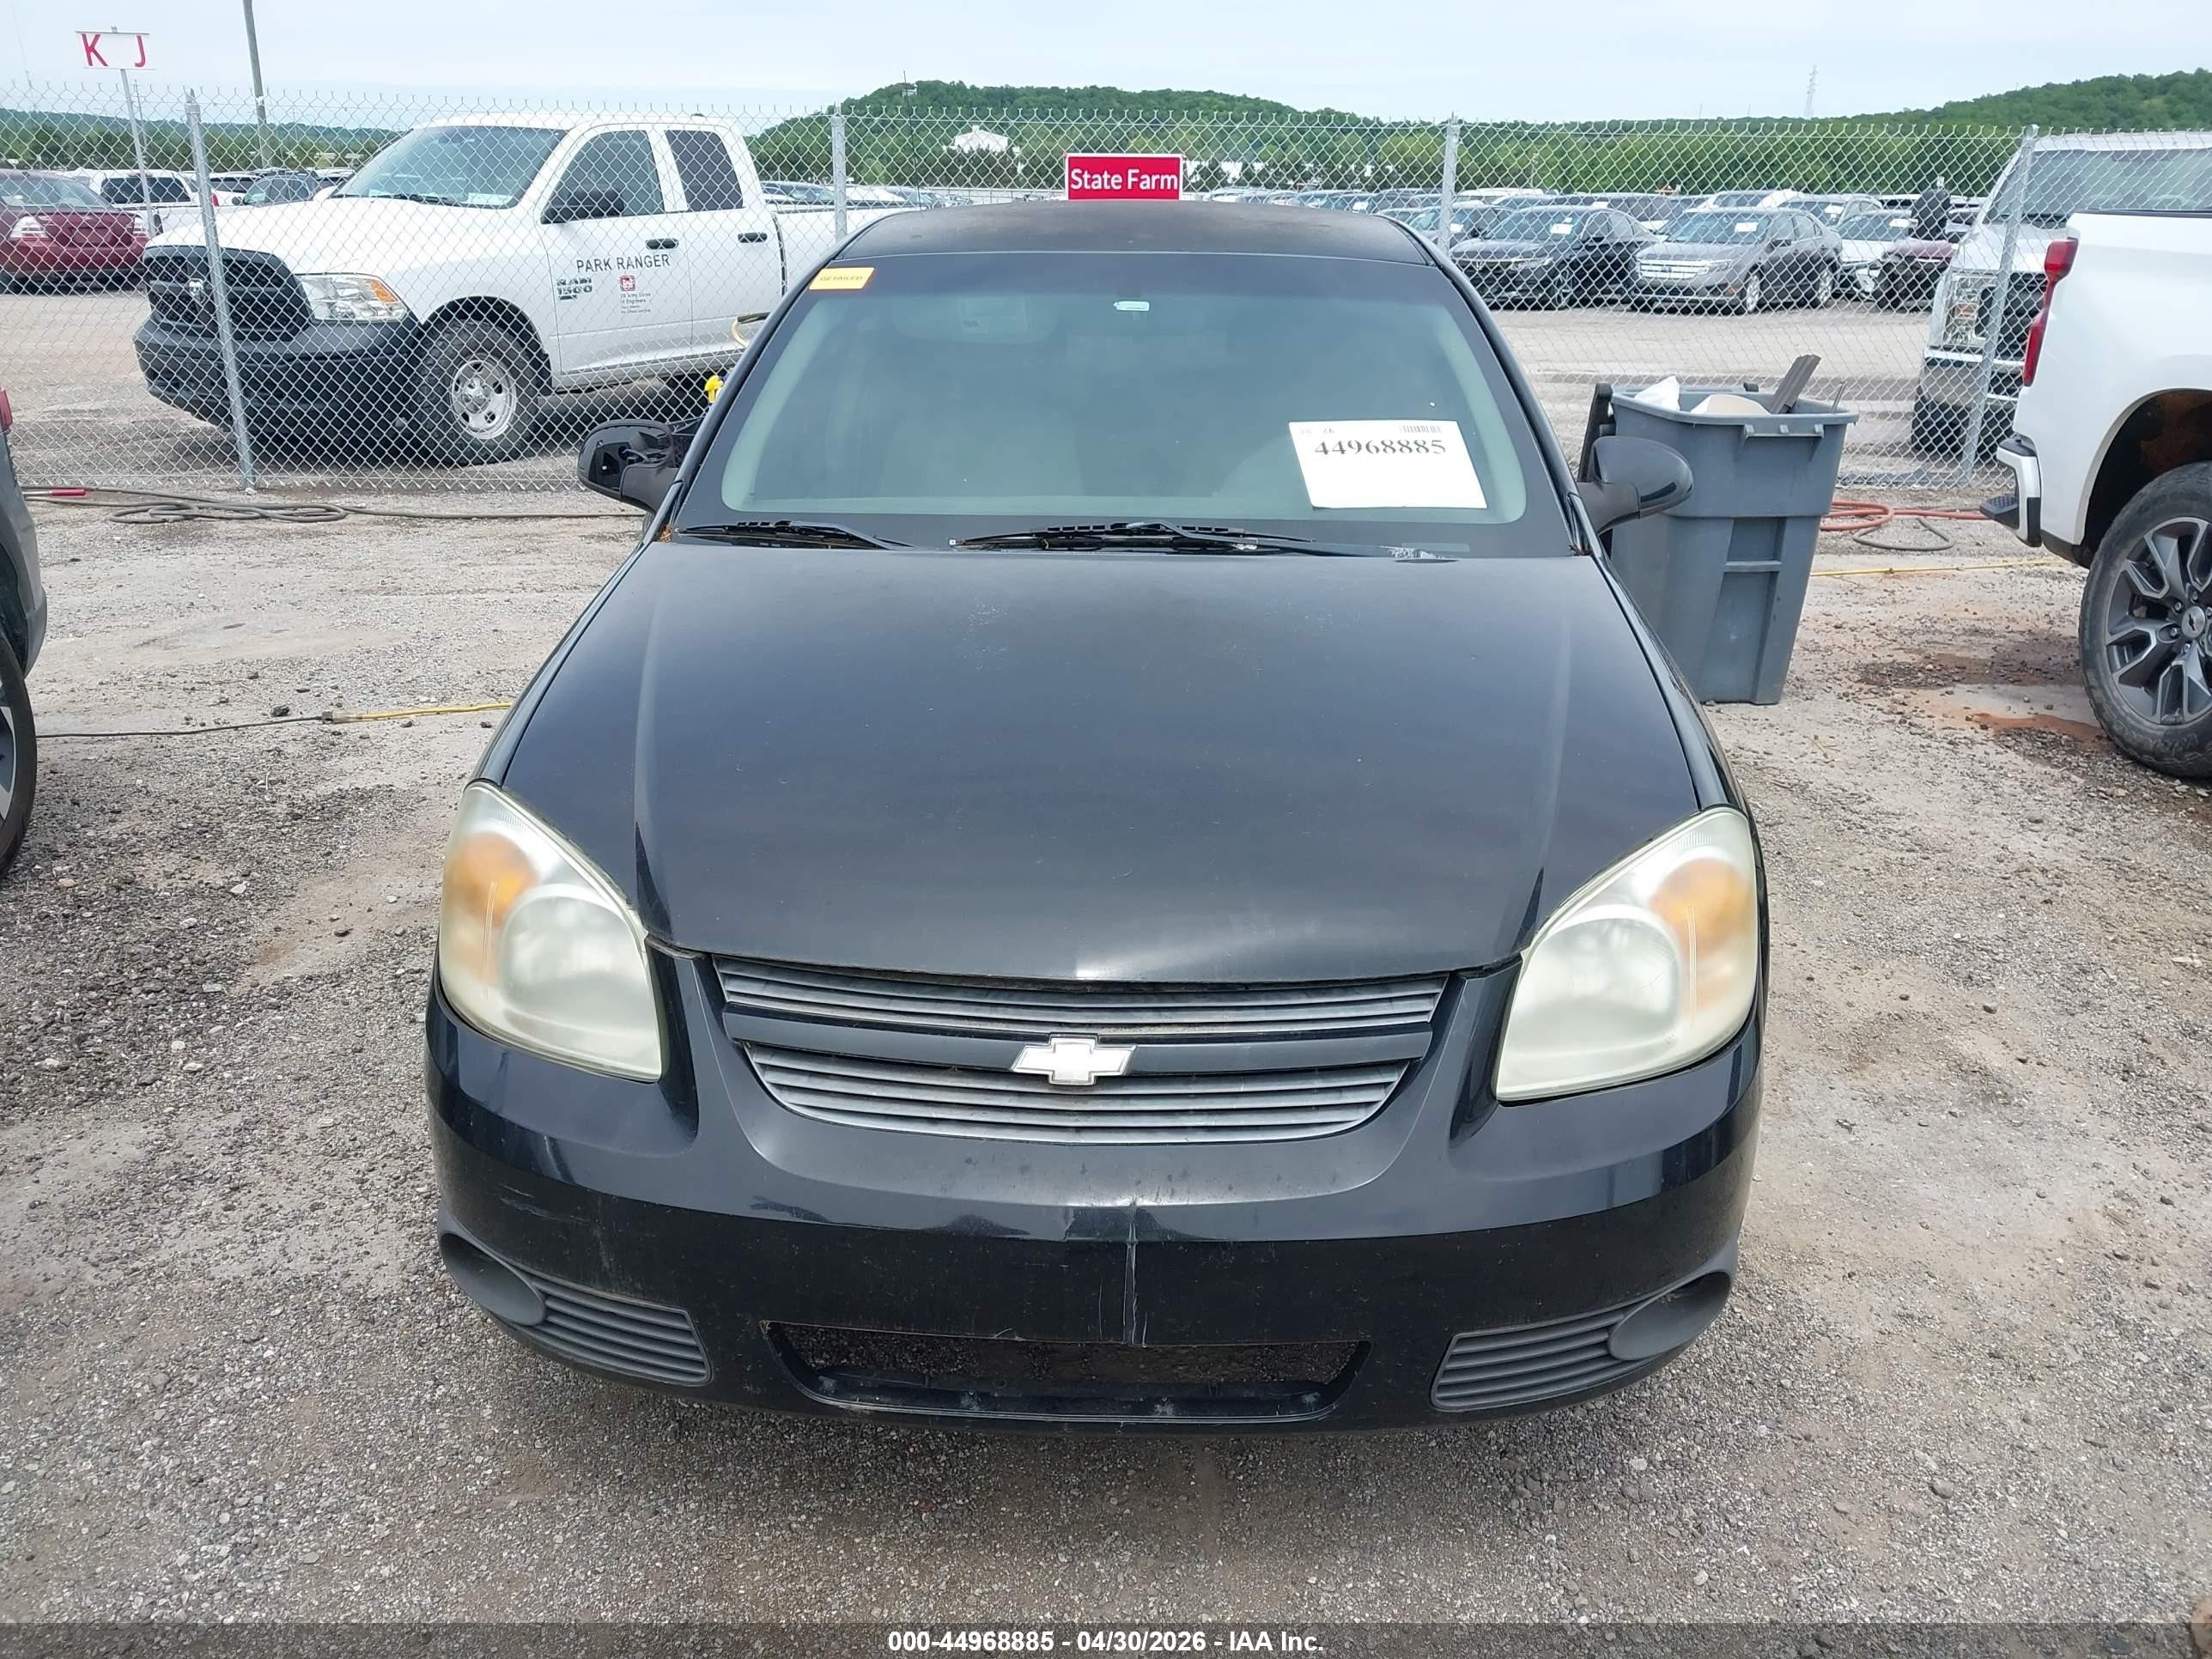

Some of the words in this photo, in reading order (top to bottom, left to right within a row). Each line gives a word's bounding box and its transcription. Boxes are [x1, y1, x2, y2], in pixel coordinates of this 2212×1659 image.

[82, 33, 108, 66] K
[135, 34, 145, 67] J
[1070, 168, 1123, 190] State
[1127, 168, 1178, 190] Farm
[576, 258, 612, 272] PARK
[617, 253, 671, 270] RANGER
[1315, 439, 1446, 455] 44968885
